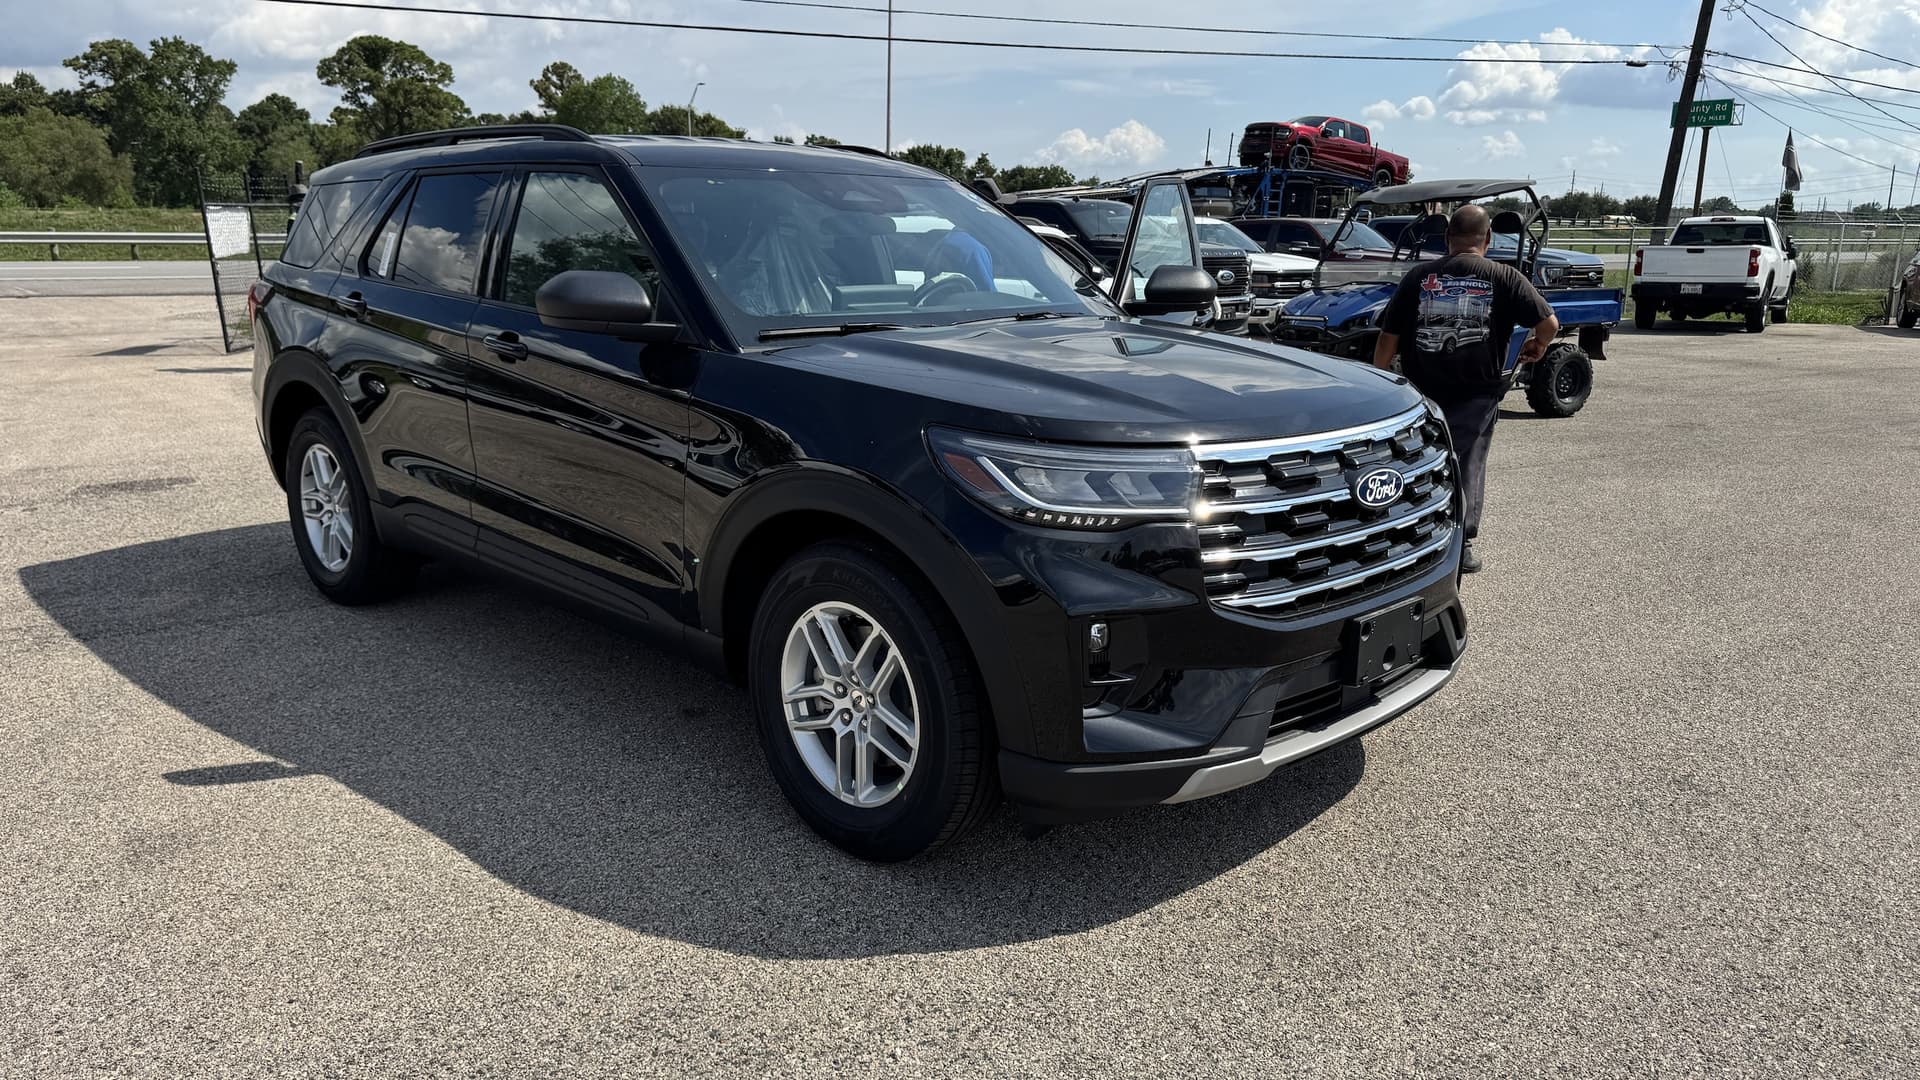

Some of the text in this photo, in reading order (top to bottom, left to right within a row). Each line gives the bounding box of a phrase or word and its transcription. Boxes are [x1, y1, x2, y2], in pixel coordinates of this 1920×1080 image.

[1690, 103, 1728, 114] unty Rd
[1366, 472, 1397, 502] Ford
